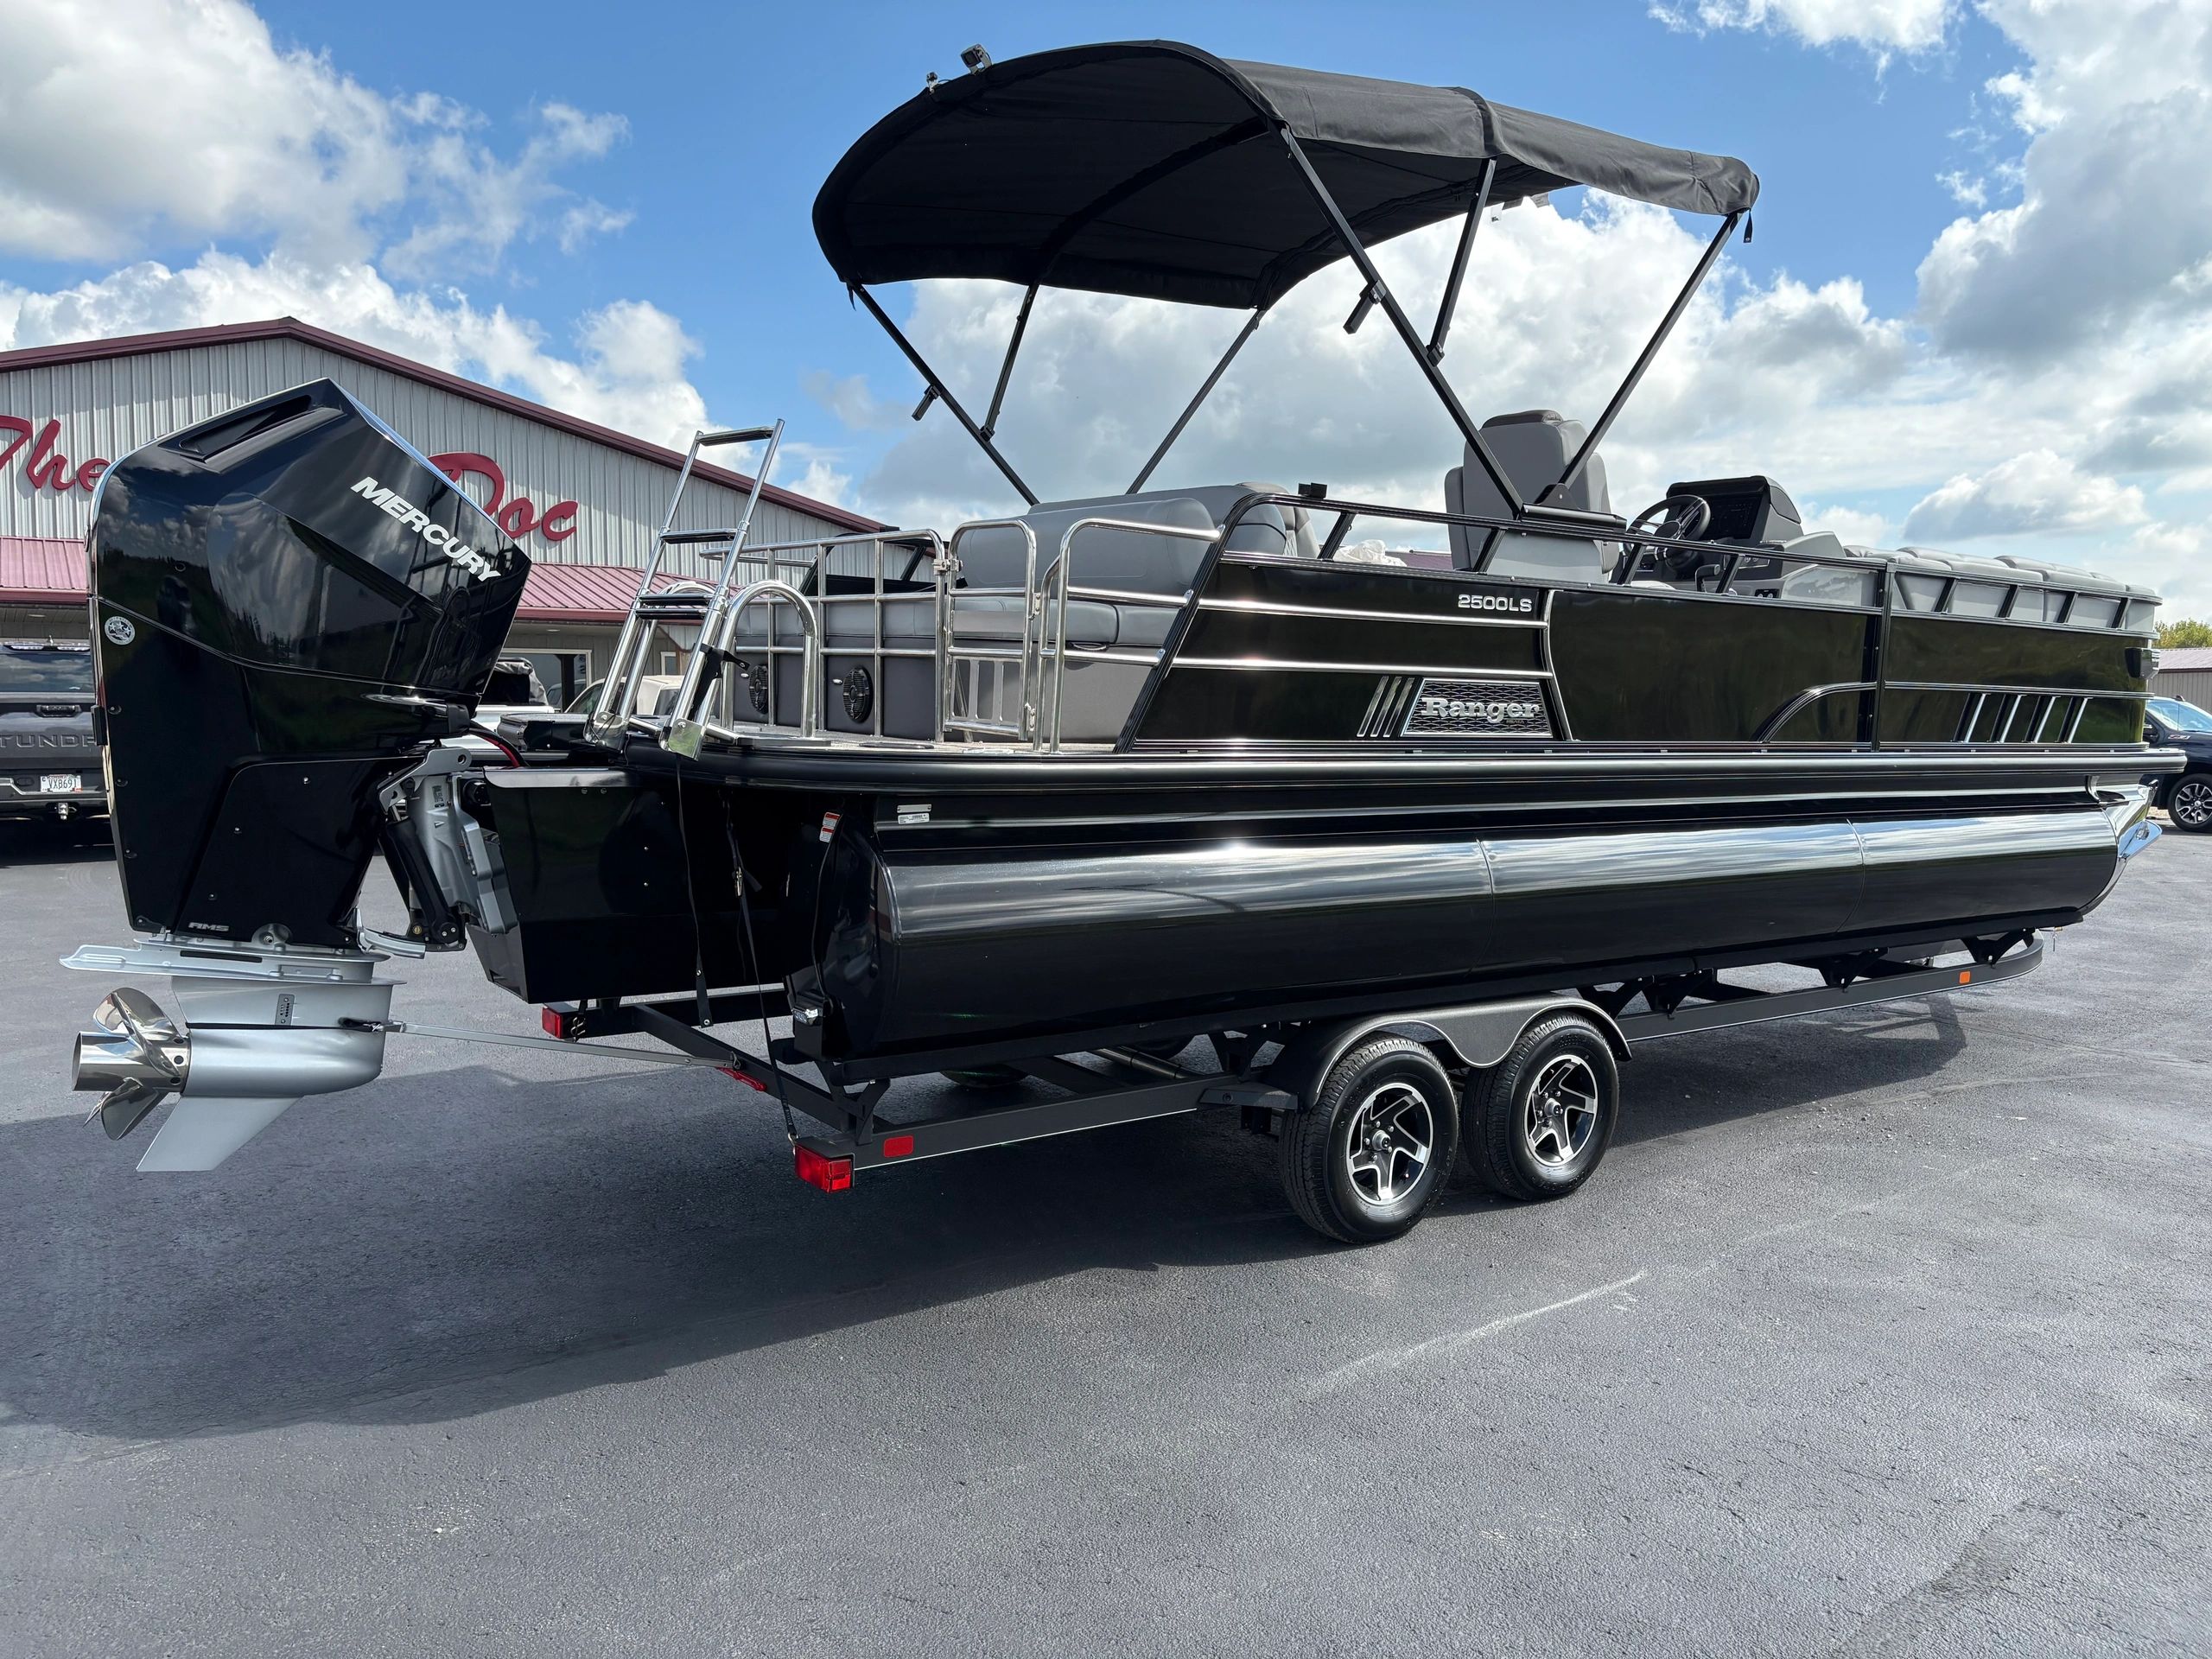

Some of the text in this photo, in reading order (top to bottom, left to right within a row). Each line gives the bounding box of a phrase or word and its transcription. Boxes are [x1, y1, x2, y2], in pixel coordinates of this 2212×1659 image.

[427, 452, 578, 542] Doc
[350, 476, 502, 582] MERCURY
[1458, 594, 1533, 613] 2500LS
[1421, 697, 1540, 724] Ranger
